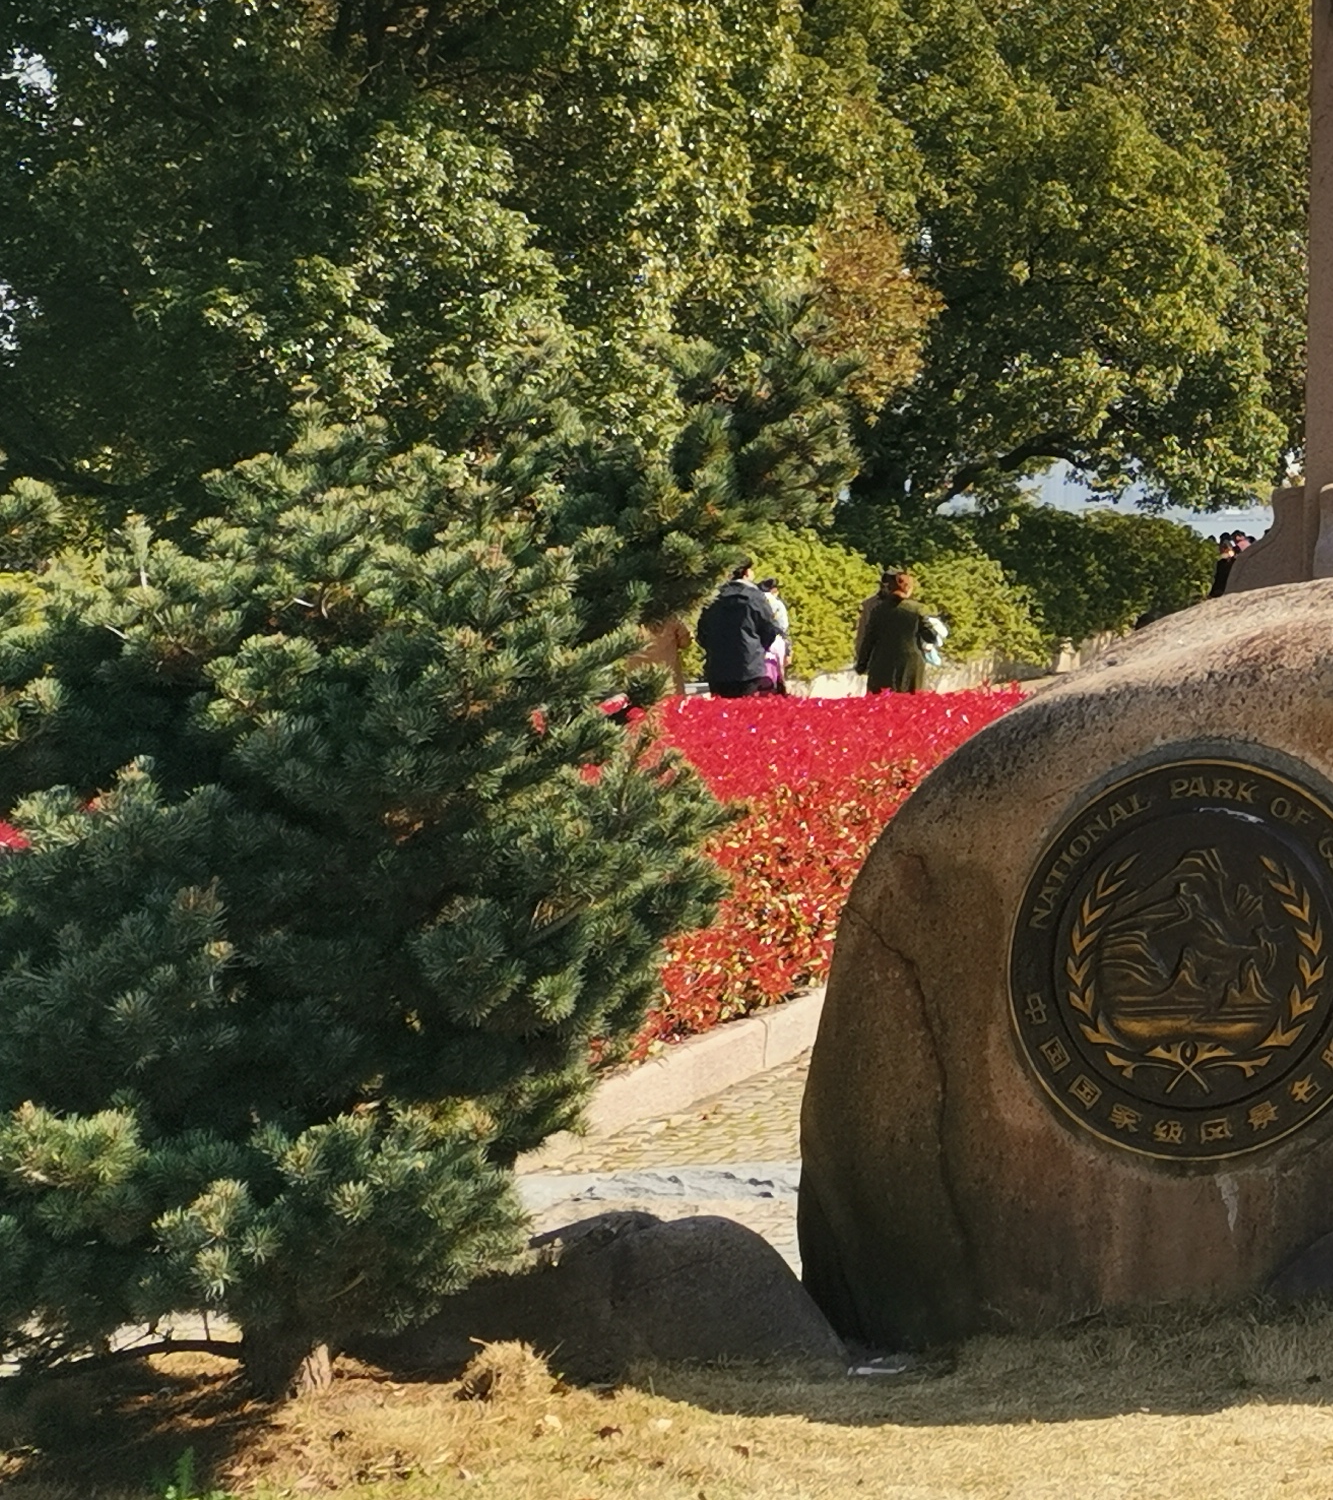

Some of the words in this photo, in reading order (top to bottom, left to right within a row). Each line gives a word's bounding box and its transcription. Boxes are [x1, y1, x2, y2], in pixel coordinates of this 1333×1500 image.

[1030, 793, 1151, 929] NATIONAL
[1170, 777, 1258, 803] PARK
[1270, 796, 1315, 827] OF
